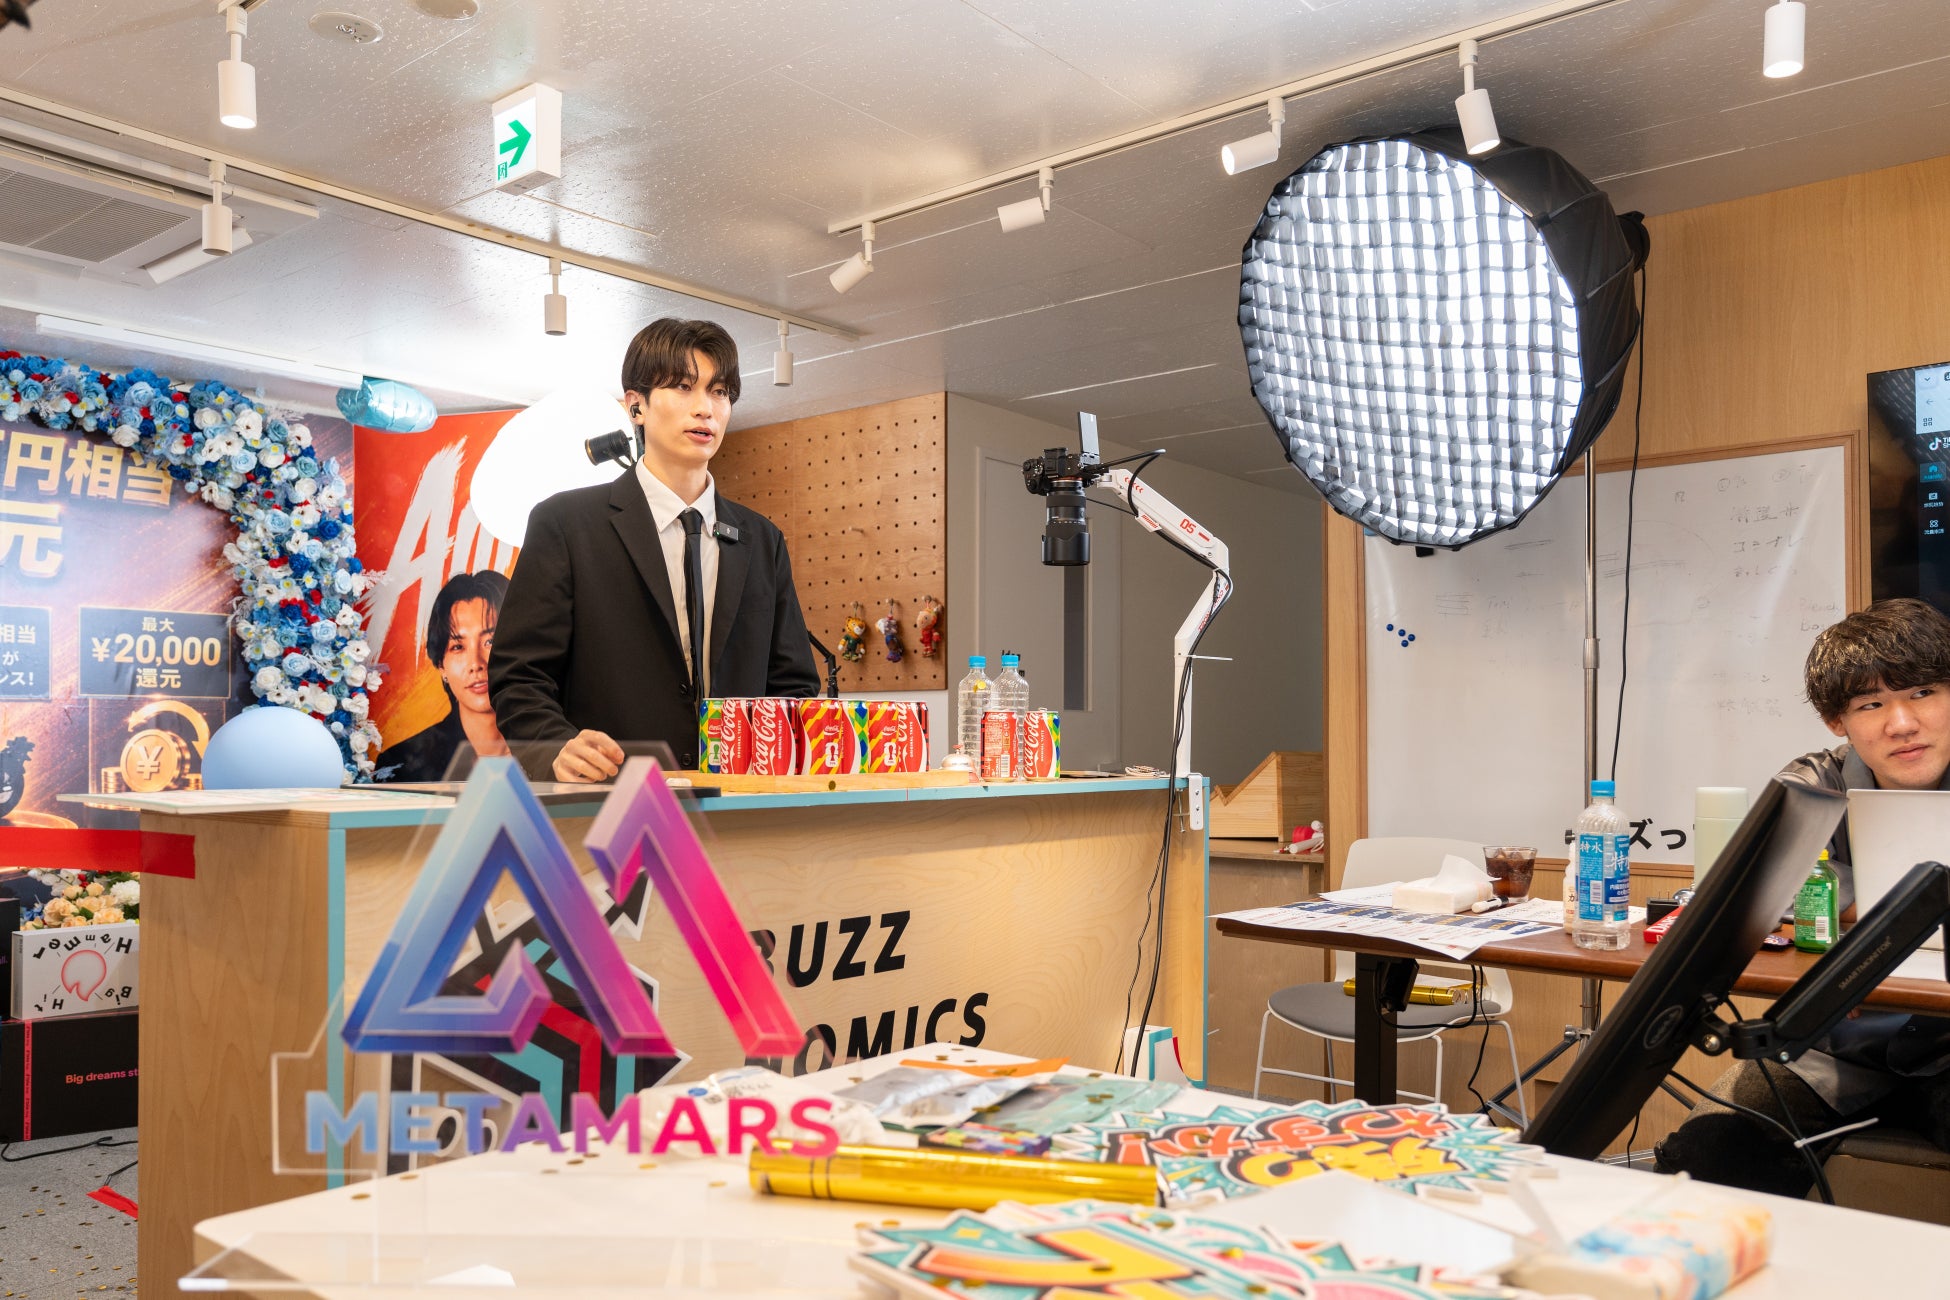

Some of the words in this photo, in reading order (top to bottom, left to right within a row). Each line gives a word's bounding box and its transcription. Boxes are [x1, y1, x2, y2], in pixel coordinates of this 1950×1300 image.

[0, 430, 173, 505] 円相当
[142, 616, 175, 633] 最大
[91, 633, 222, 667] ¥20,000
[135, 667, 182, 689] 還元
[1629, 818, 1695, 850] ズっ
[1605, 850, 1630, 872] 特
[104, 985, 133, 1006] Big
[744, 992, 989, 1078] OMICS
[65, 1073, 84, 1085] Big
[85, 1069, 127, 1082] dreams
[127, 1067, 139, 1077] st
[304, 1090, 841, 1158] METAMARS
